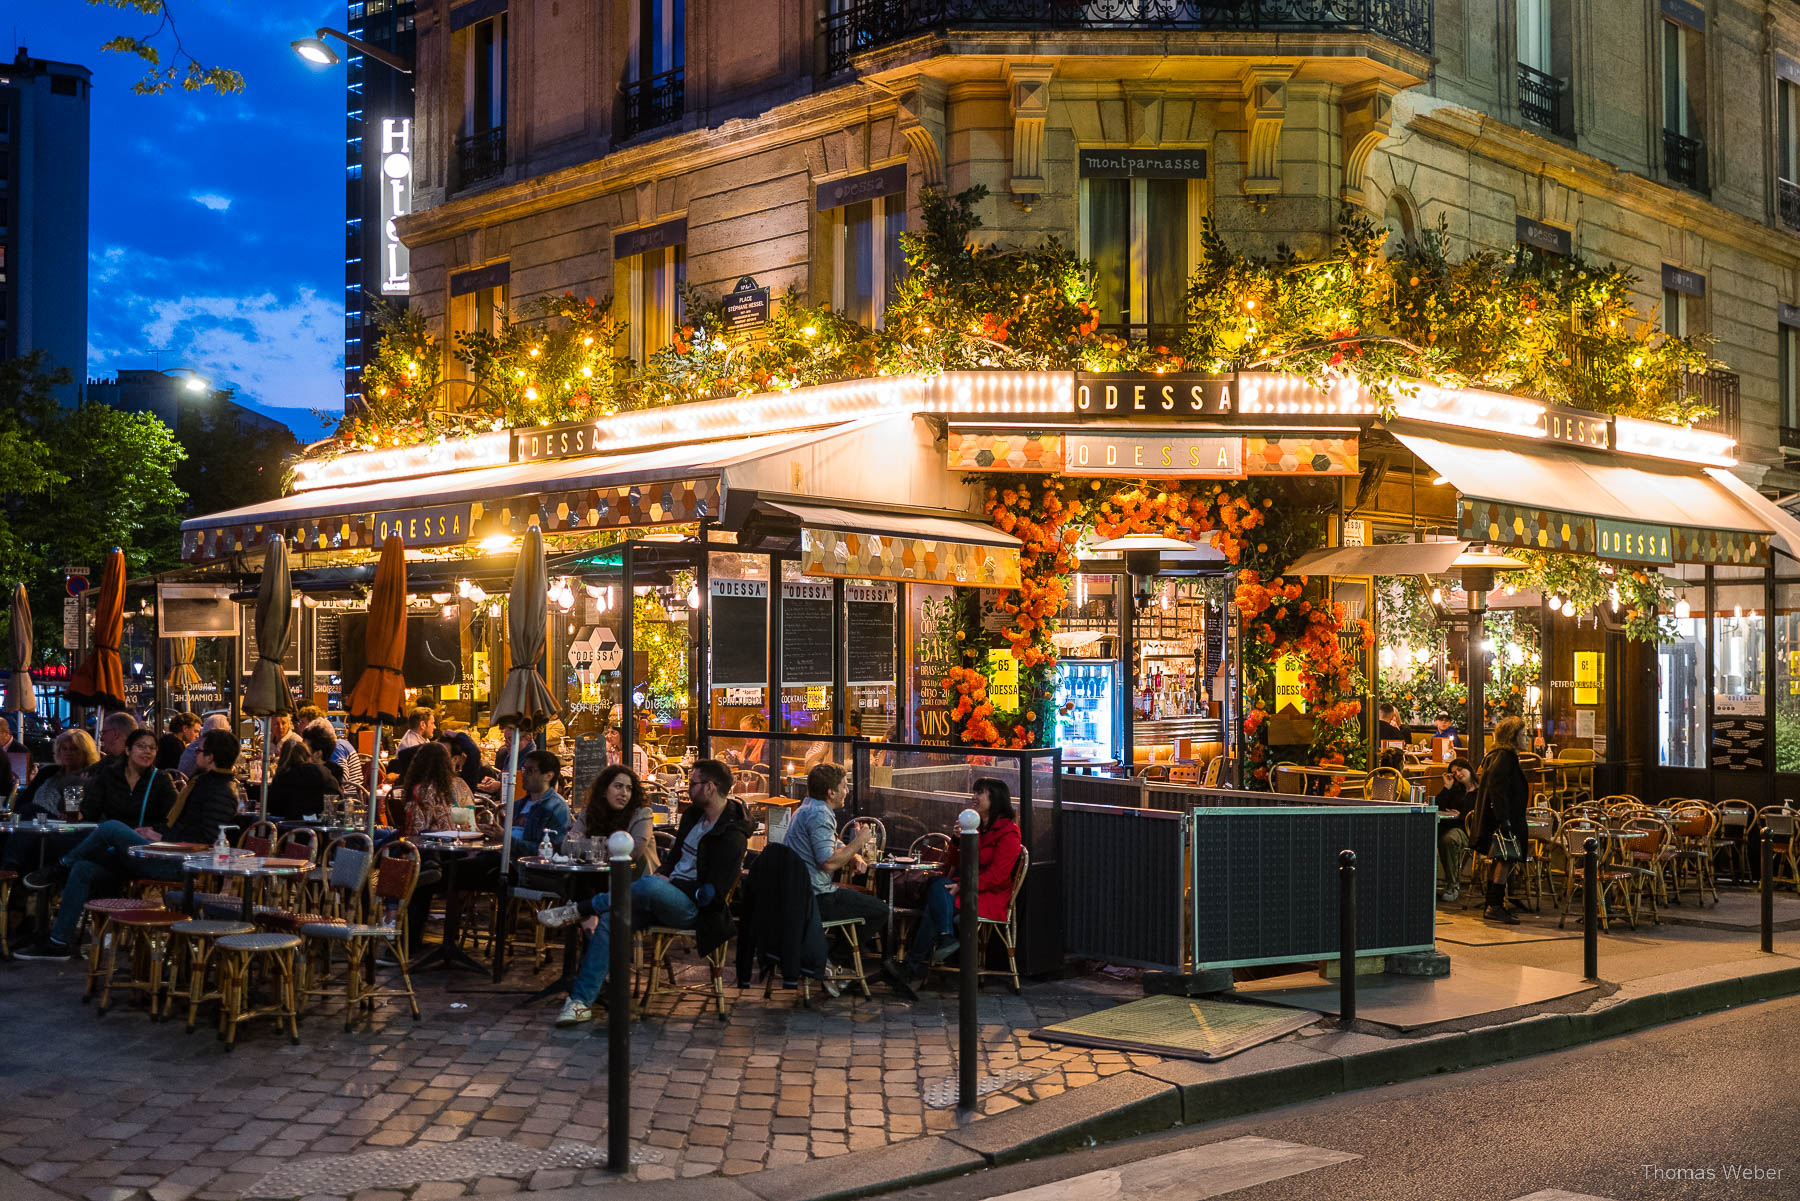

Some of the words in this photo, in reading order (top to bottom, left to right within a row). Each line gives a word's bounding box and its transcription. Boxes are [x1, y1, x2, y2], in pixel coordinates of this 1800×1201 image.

[1086, 156, 1200, 177] montparnasse
[1078, 385, 1232, 410] ODESSA
[518, 428, 599, 457] ODESSA
[1079, 445, 1228, 467] ODESSA
[380, 514, 460, 541] ODESSA
[1602, 530, 1668, 558] ODESSA
[998, 660, 1009, 671] 65
[1277, 685, 1303, 695] ODESS
[920, 710, 950, 736] VINS
